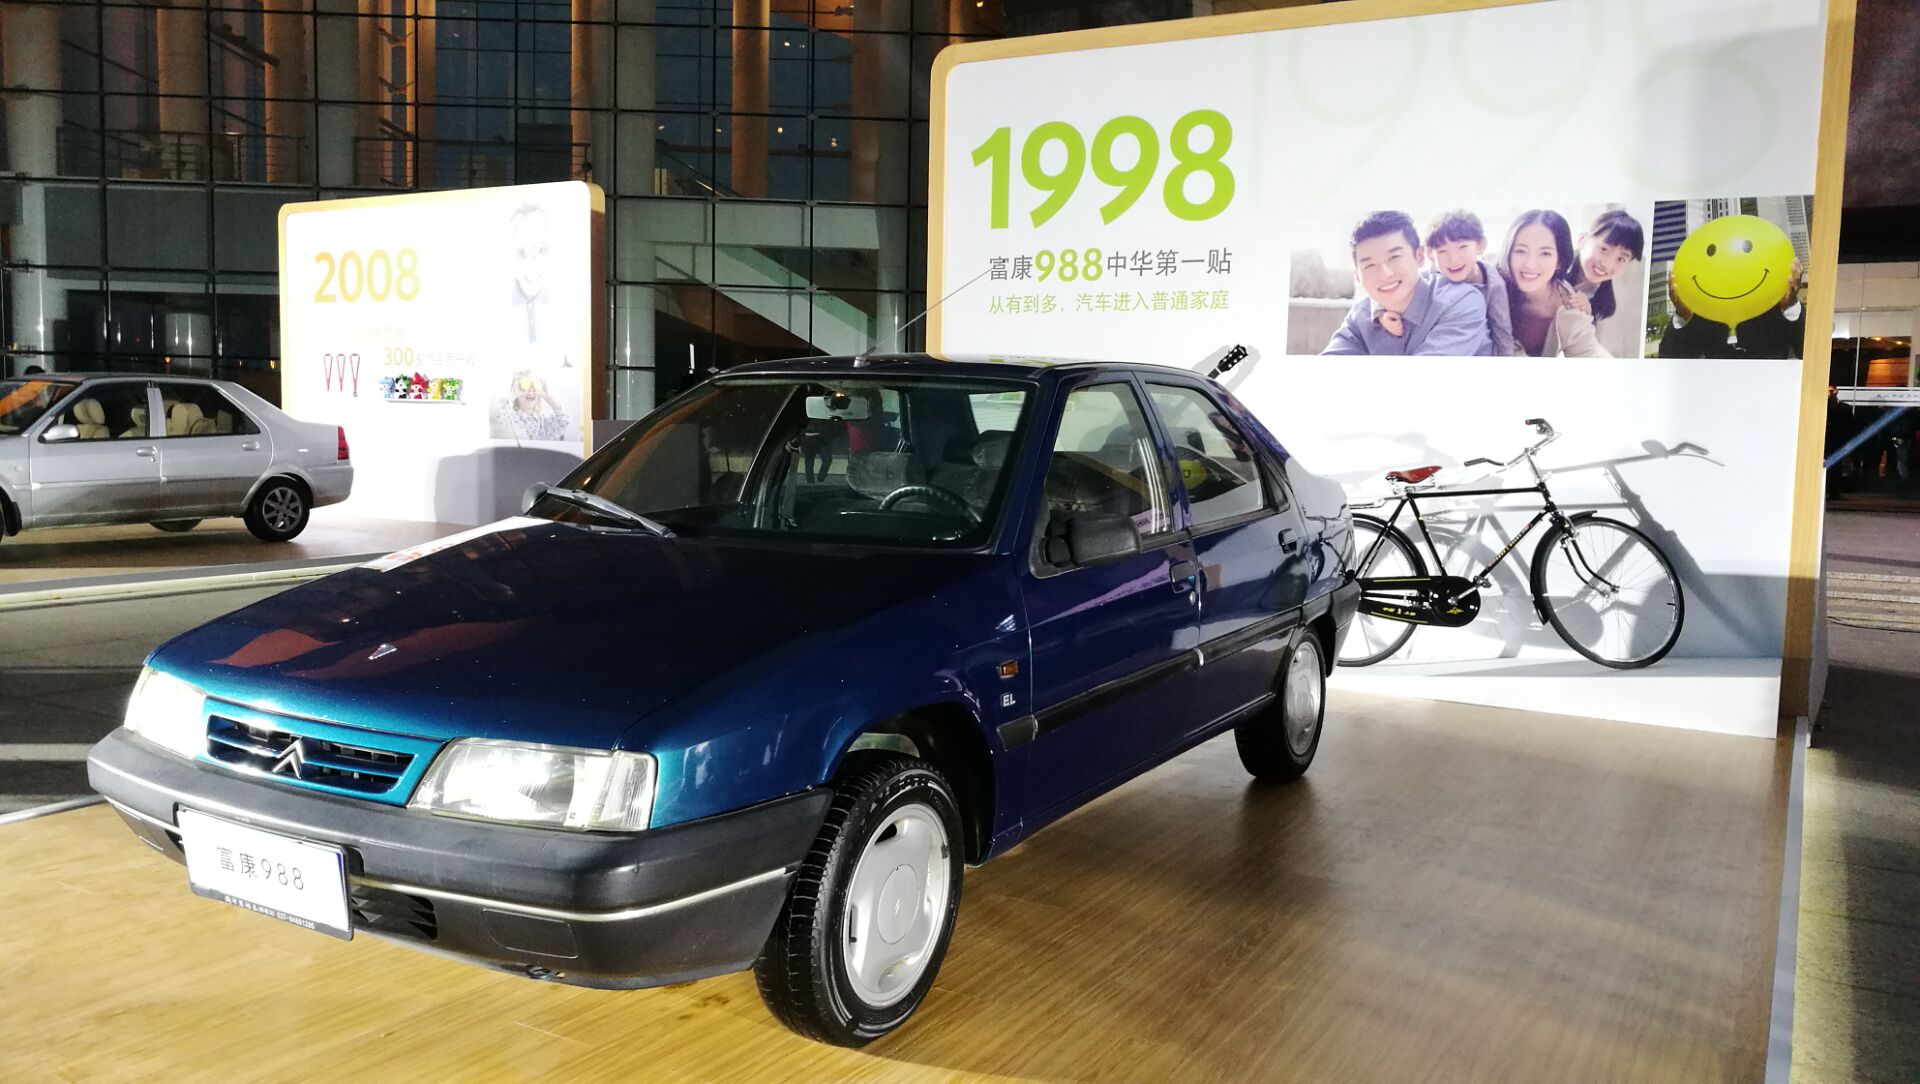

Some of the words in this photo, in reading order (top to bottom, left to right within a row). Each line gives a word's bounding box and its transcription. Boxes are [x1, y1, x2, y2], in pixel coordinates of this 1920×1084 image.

[971, 109, 1235, 229] 1998
[314, 248, 421, 303] 2008
[989, 247, 1233, 283] 富康988中华第一贴
[1002, 693, 1017, 707] EL
[217, 846, 304, 890] 富康988
